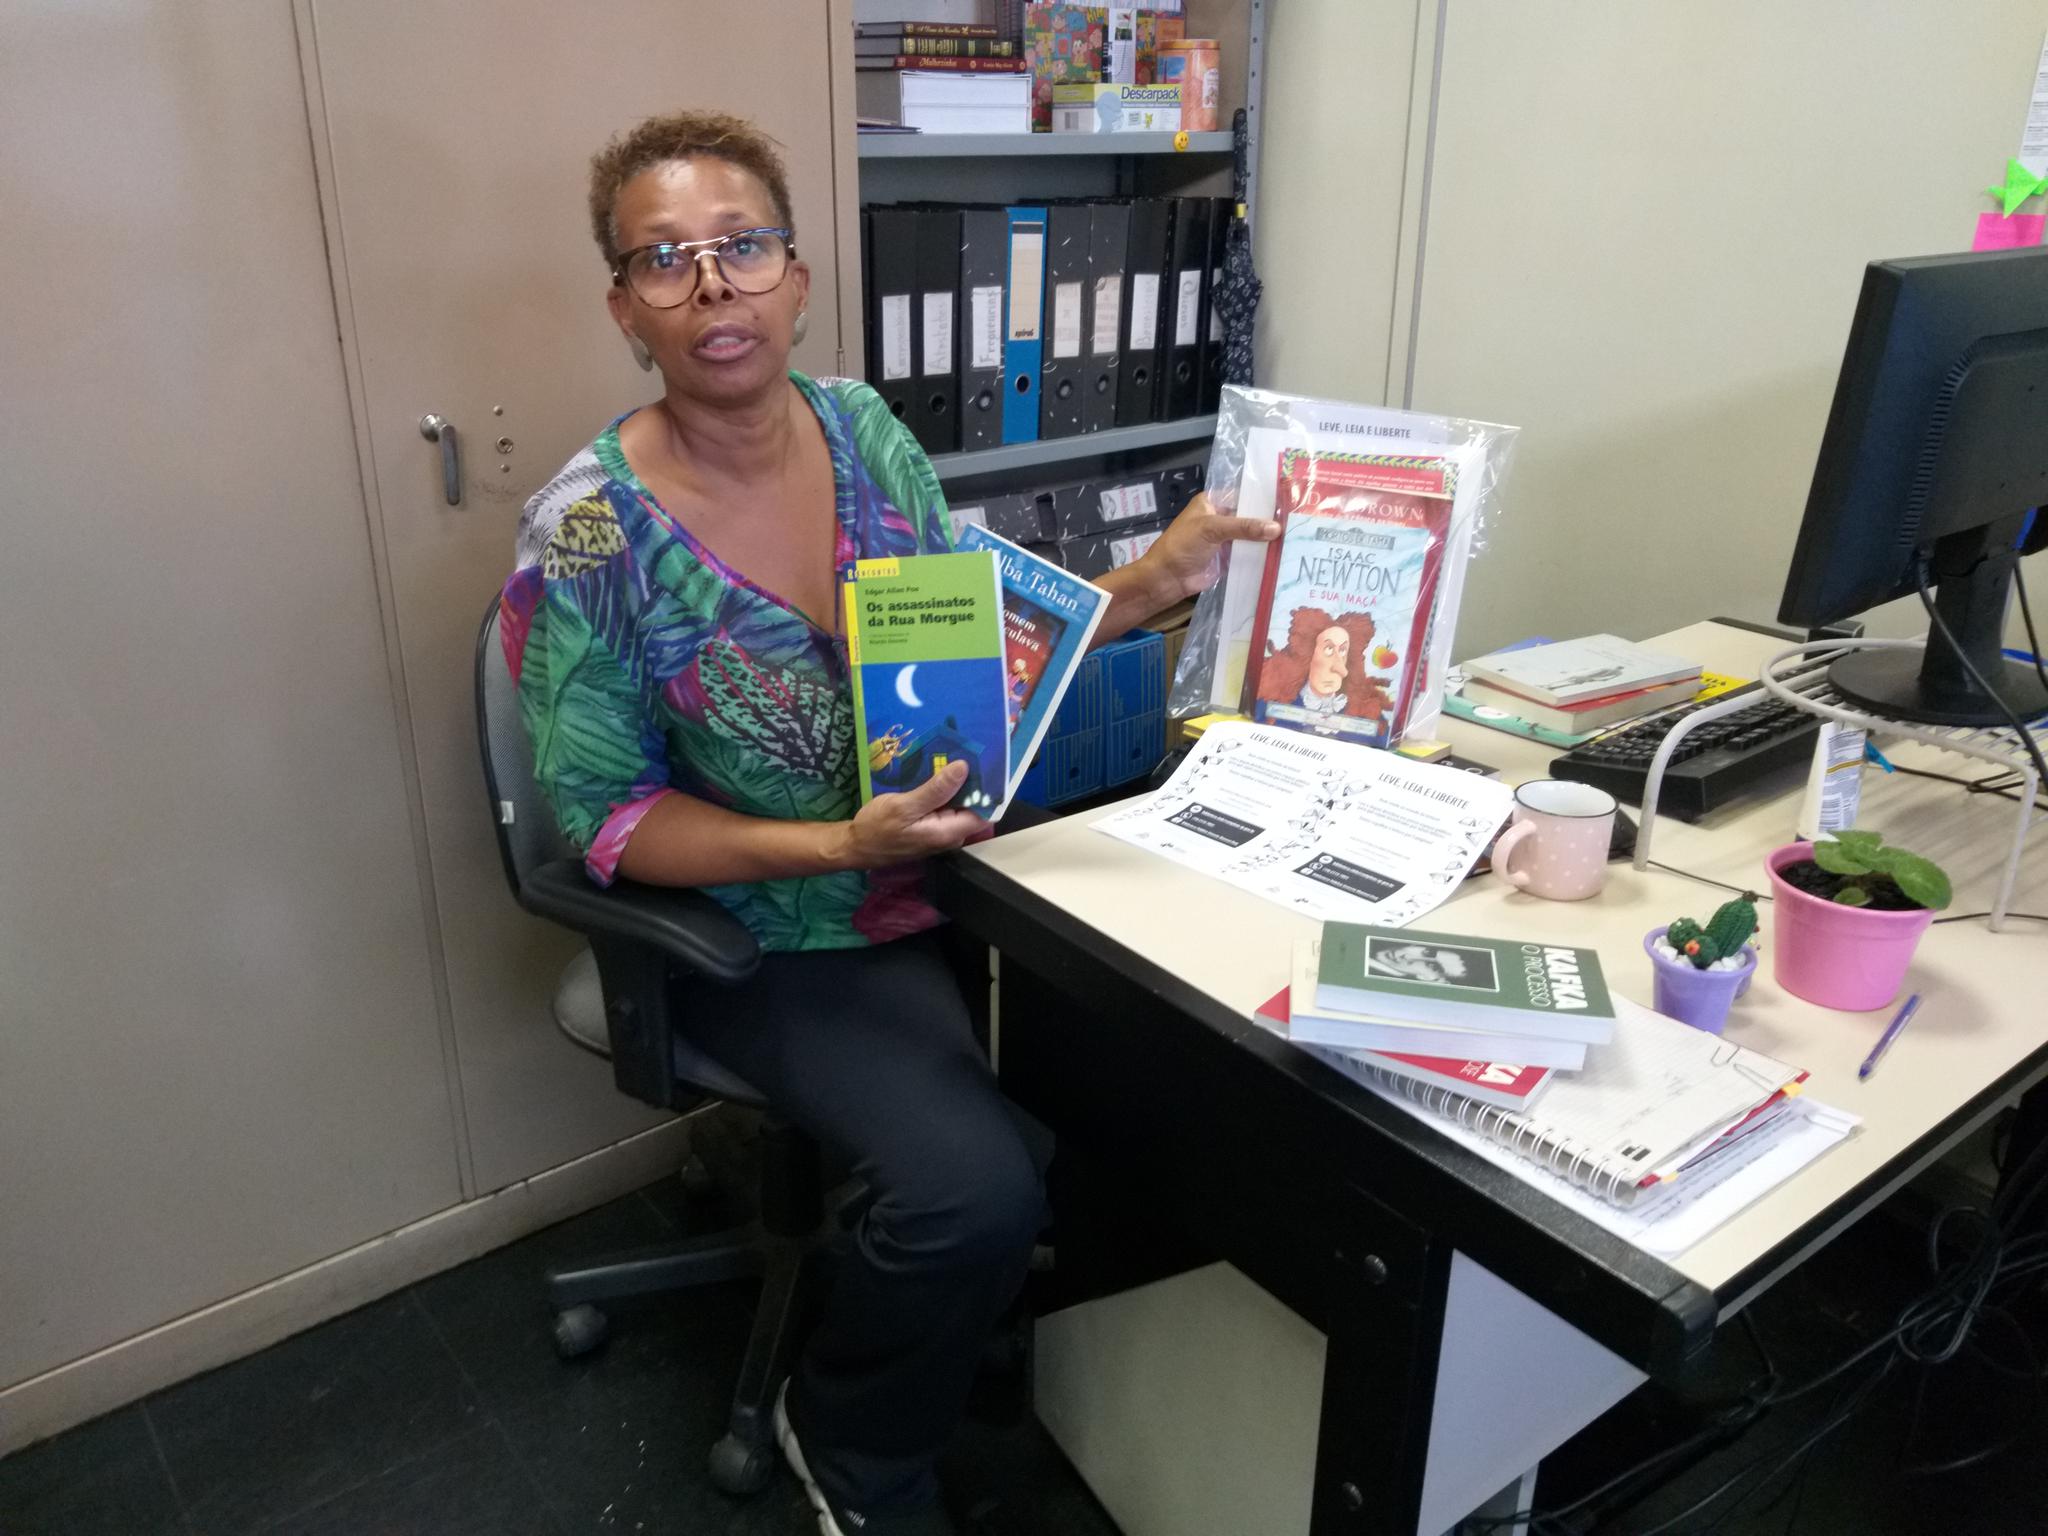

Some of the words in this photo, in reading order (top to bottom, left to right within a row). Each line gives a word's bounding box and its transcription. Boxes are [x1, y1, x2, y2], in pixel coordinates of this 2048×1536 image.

[1121, 86, 1179, 102] Descarpack
[1319, 421, 1343, 434] LEVE,
[1345, 424, 1365, 434] LEIA
[1366, 425, 1373, 435] E
[1374, 426, 1411, 439] LIBERTE
[1361, 501, 1424, 521] ROWN
[1327, 547, 1377, 565] ISAAC
[1296, 556, 1403, 598] NEWTON
[865, 588, 885, 596] Edgar
[1031, 571, 1078, 612] Tahan
[1309, 589, 1317, 599] E
[1321, 590, 1340, 601] SUA
[867, 602, 883, 613] Os
[888, 596, 976, 612] assassinatos
[868, 616, 884, 627] da
[889, 615, 915, 626] Rua
[920, 612, 976, 626] Morgue
[1004, 608, 1037, 633] omem
[1378, 772, 1401, 787] LEVE,
[1402, 780, 1423, 795] LEIA
[1423, 788, 1431, 797] E
[1430, 790, 1470, 809] LIBERTE
[1521, 944, 1542, 955] O
[1523, 956, 1552, 1008] PROCESSO
[1543, 947, 1589, 1010] KAFKA
